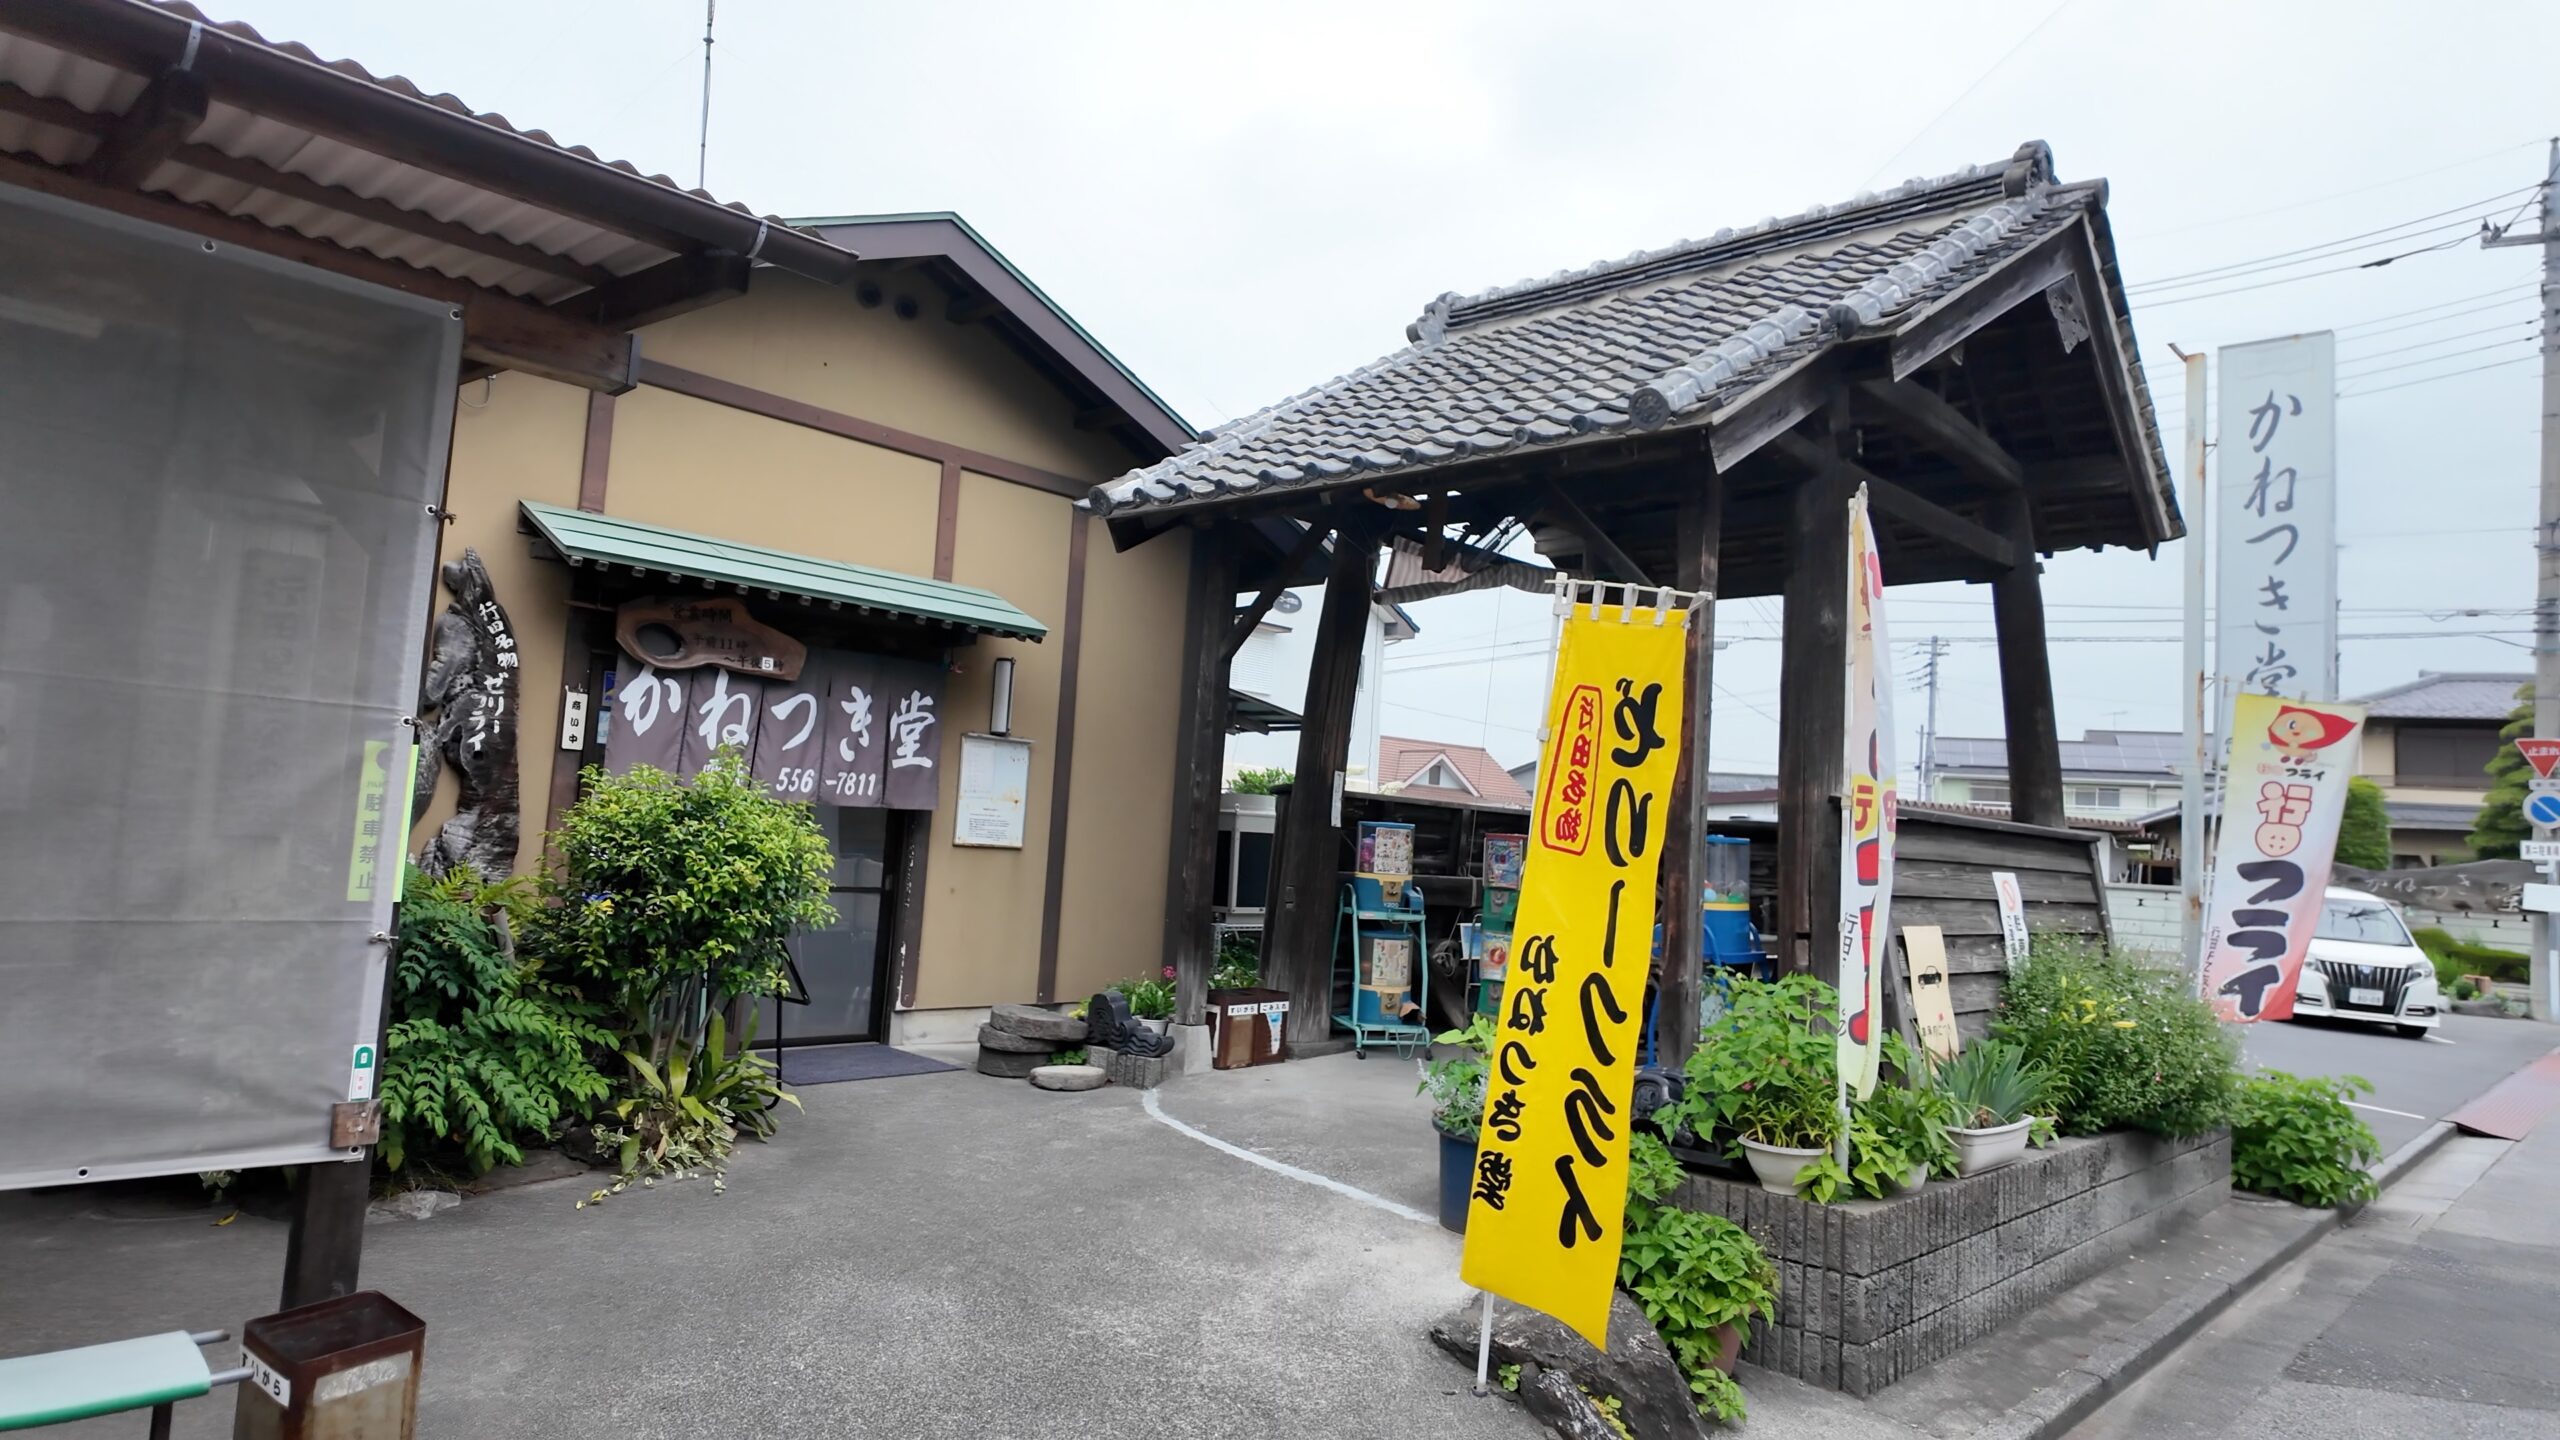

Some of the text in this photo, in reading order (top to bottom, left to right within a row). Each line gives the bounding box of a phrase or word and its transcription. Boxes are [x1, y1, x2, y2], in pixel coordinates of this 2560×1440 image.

[478, 600, 519, 668] 行田名物
[466, 693, 488, 751] フライ
[619, 665, 935, 769] かねつき堂
[776, 767, 815, 793] 556
